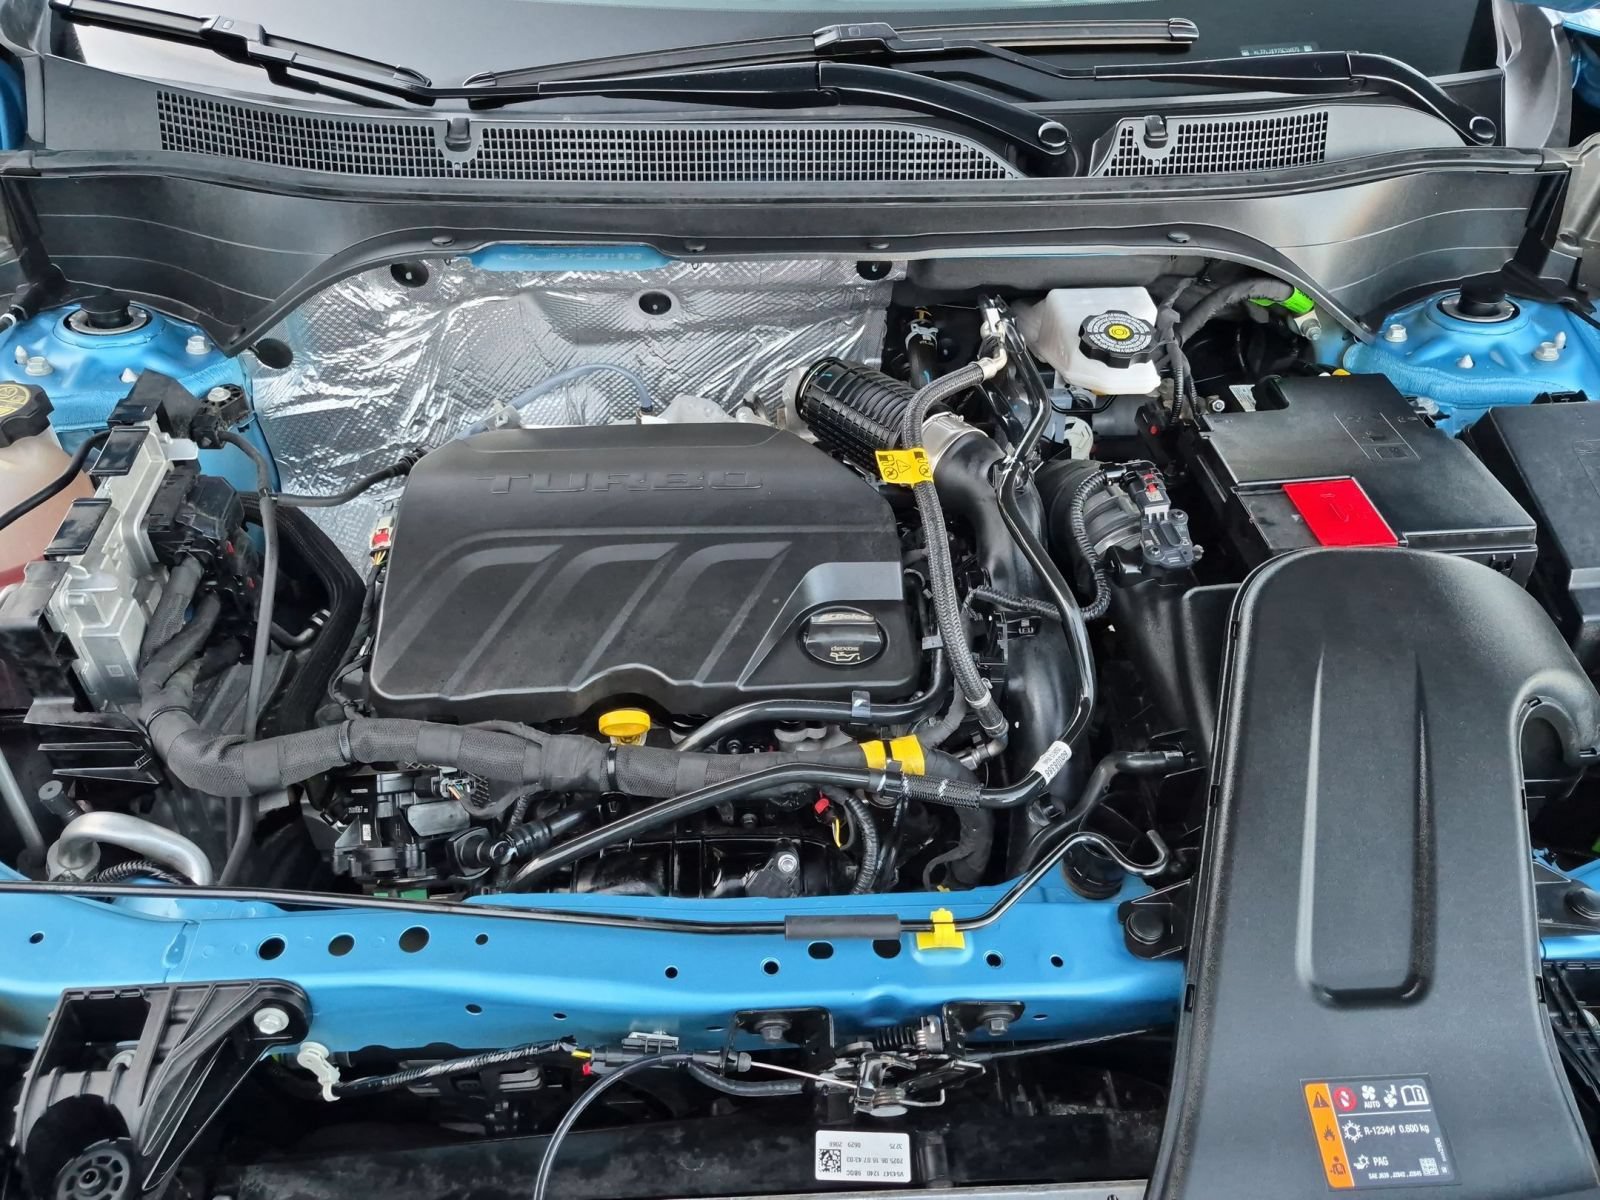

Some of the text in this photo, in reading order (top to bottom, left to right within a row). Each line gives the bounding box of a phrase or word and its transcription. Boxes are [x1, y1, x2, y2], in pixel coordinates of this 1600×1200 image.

[474, 471, 763, 494] TURBO
[1364, 1124, 1430, 1136] R-1234yf 0.600 kg
[1373, 1156, 1389, 1166] PAG
